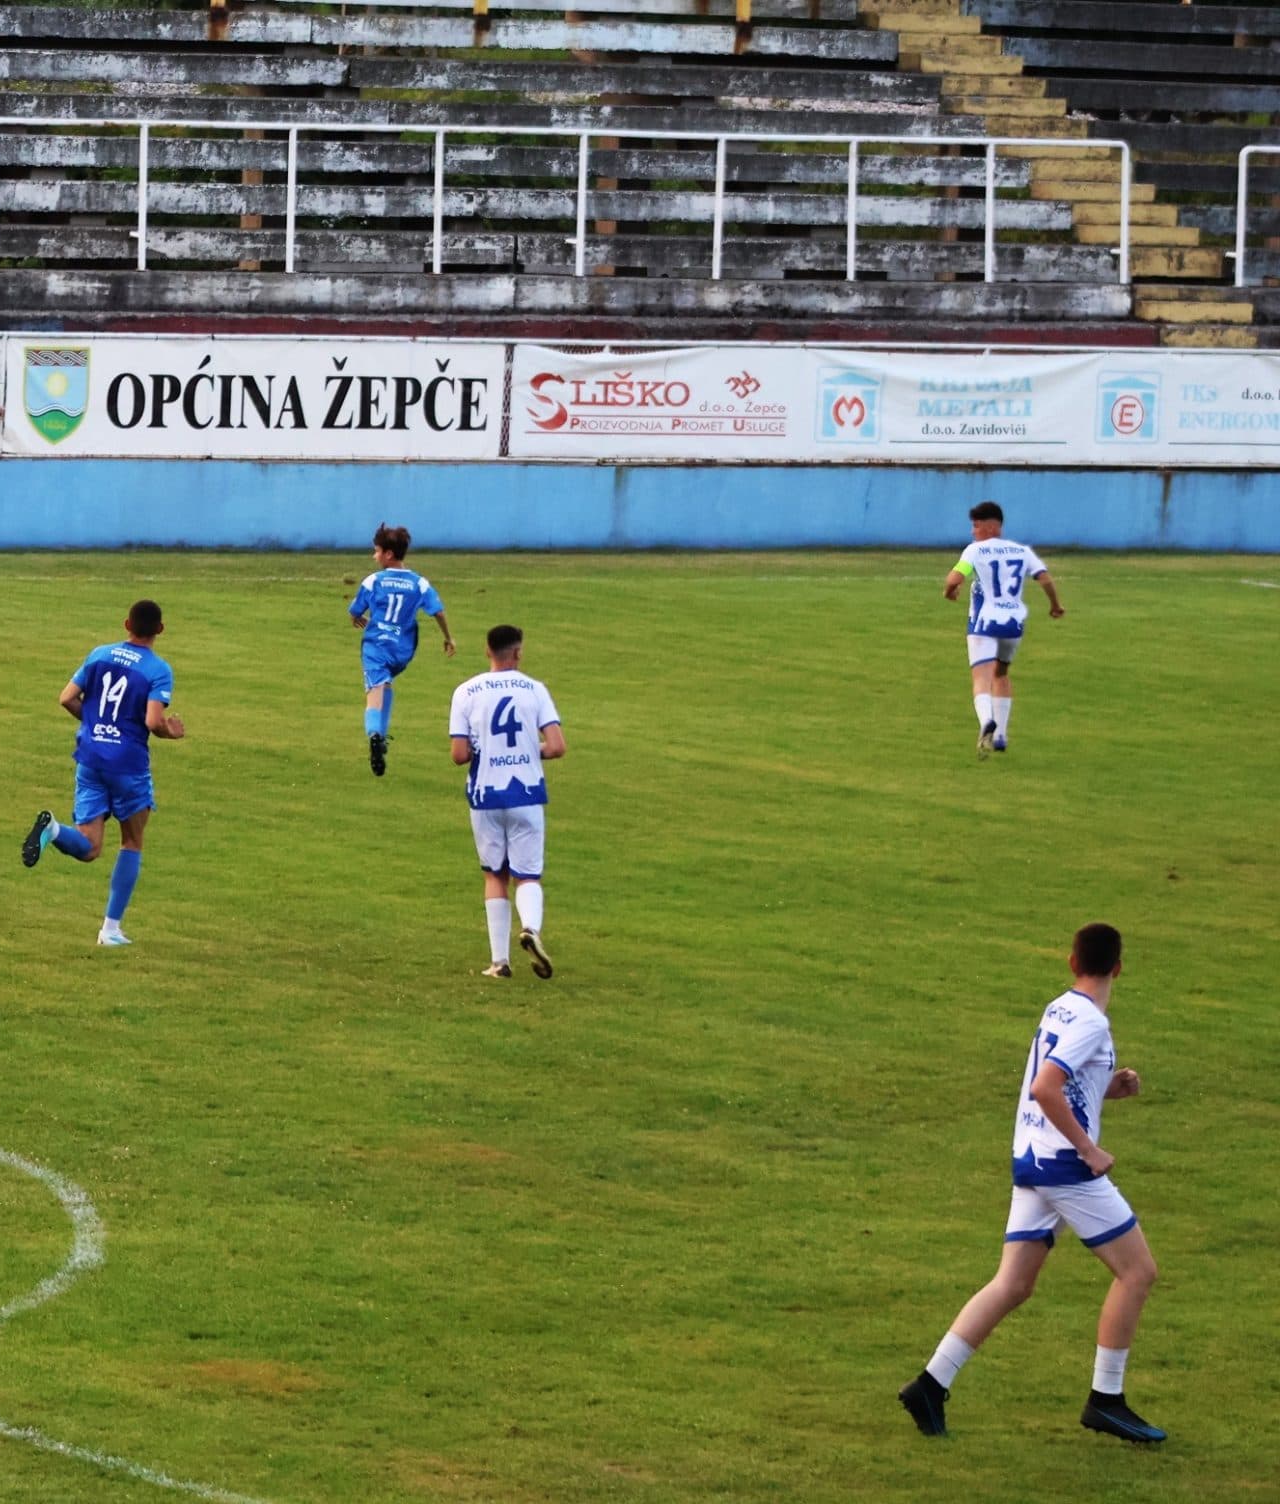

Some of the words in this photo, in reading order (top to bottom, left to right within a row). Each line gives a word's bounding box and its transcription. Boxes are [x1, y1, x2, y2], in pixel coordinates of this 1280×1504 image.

[106, 354, 308, 430] OPĆINA
[321, 356, 488, 432] ŽEPČE
[527, 371, 690, 431] SLIŠKO
[1242, 387, 1275, 400] d.o.o.
[916, 399, 1033, 417] METALI
[570, 417, 663, 432] PROIZVODNJA
[671, 418, 724, 432] PROMET
[733, 419, 786, 432] USLUGE
[921, 423, 955, 435] d.o.o.
[988, 559, 1024, 598] 13
[384, 593, 404, 623] 11
[99, 671, 128, 722] 14
[485, 679, 534, 690] NATRON
[491, 696, 522, 748] 4
[489, 754, 530, 767] MAGLAJ
